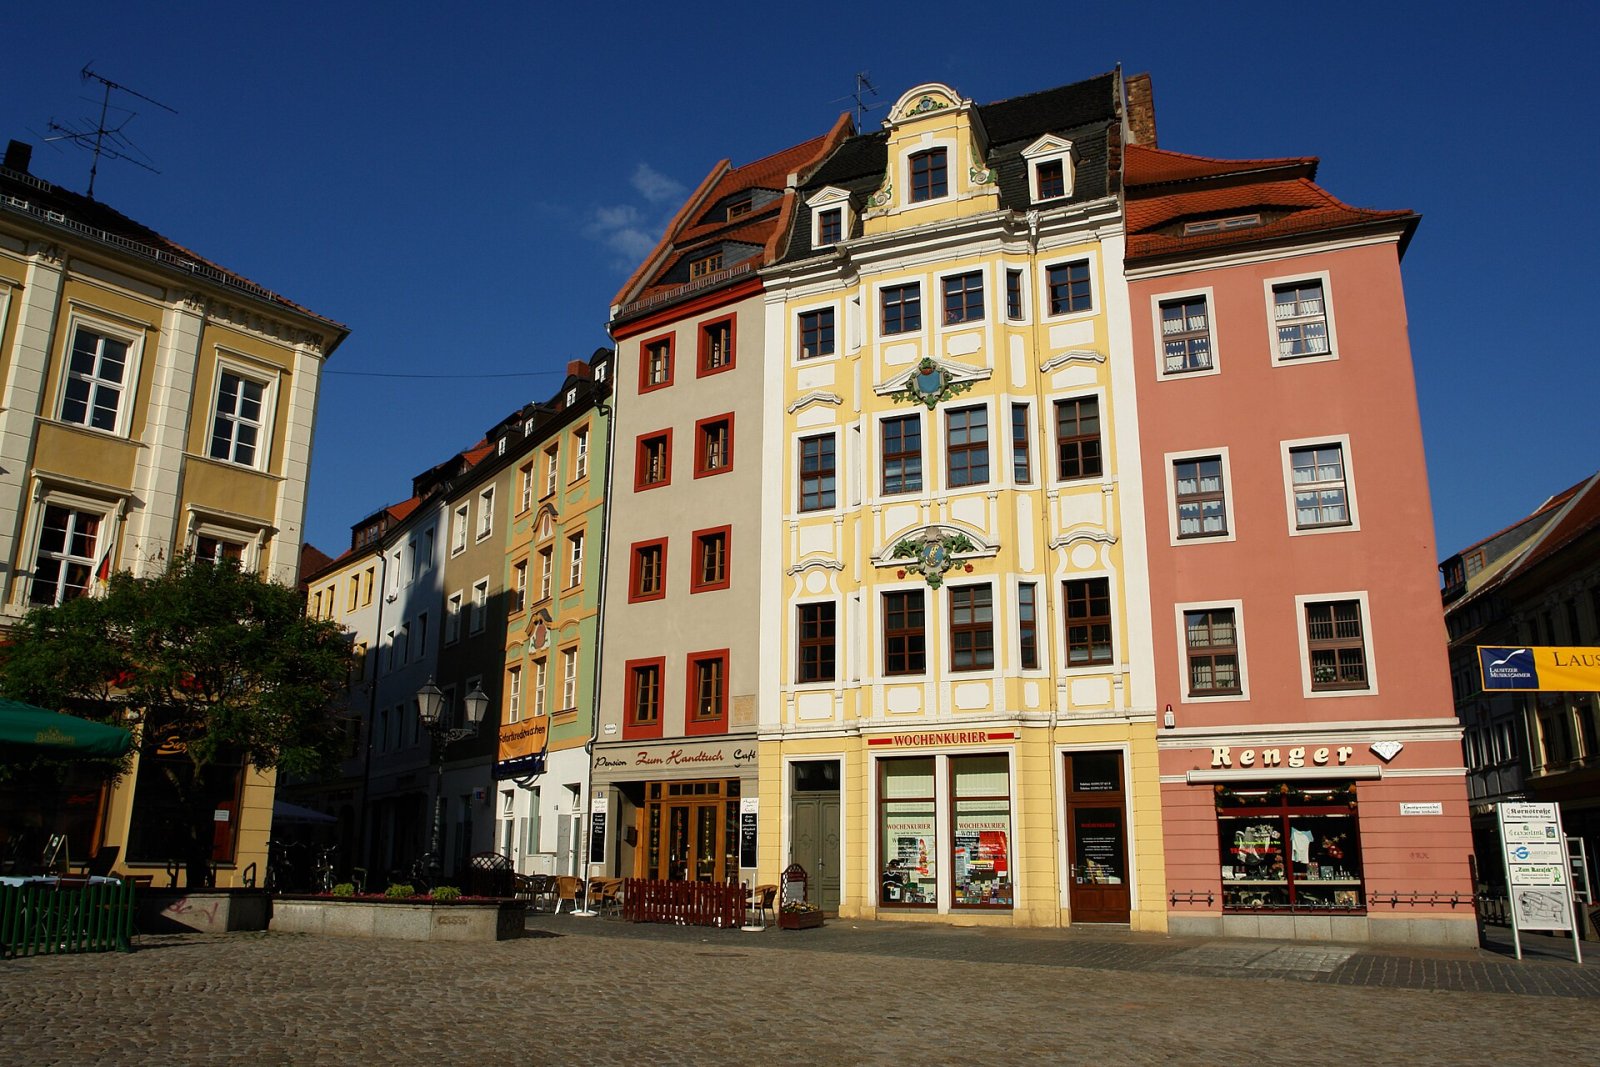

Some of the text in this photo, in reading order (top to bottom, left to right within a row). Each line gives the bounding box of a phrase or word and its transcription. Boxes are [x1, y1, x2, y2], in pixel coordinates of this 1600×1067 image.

[894, 731, 987, 746] WOCHENKURIER
[594, 756, 627, 769] Pension
[635, 749, 724, 765] Zum Handtuch
[1211, 746, 1353, 768] Renger
